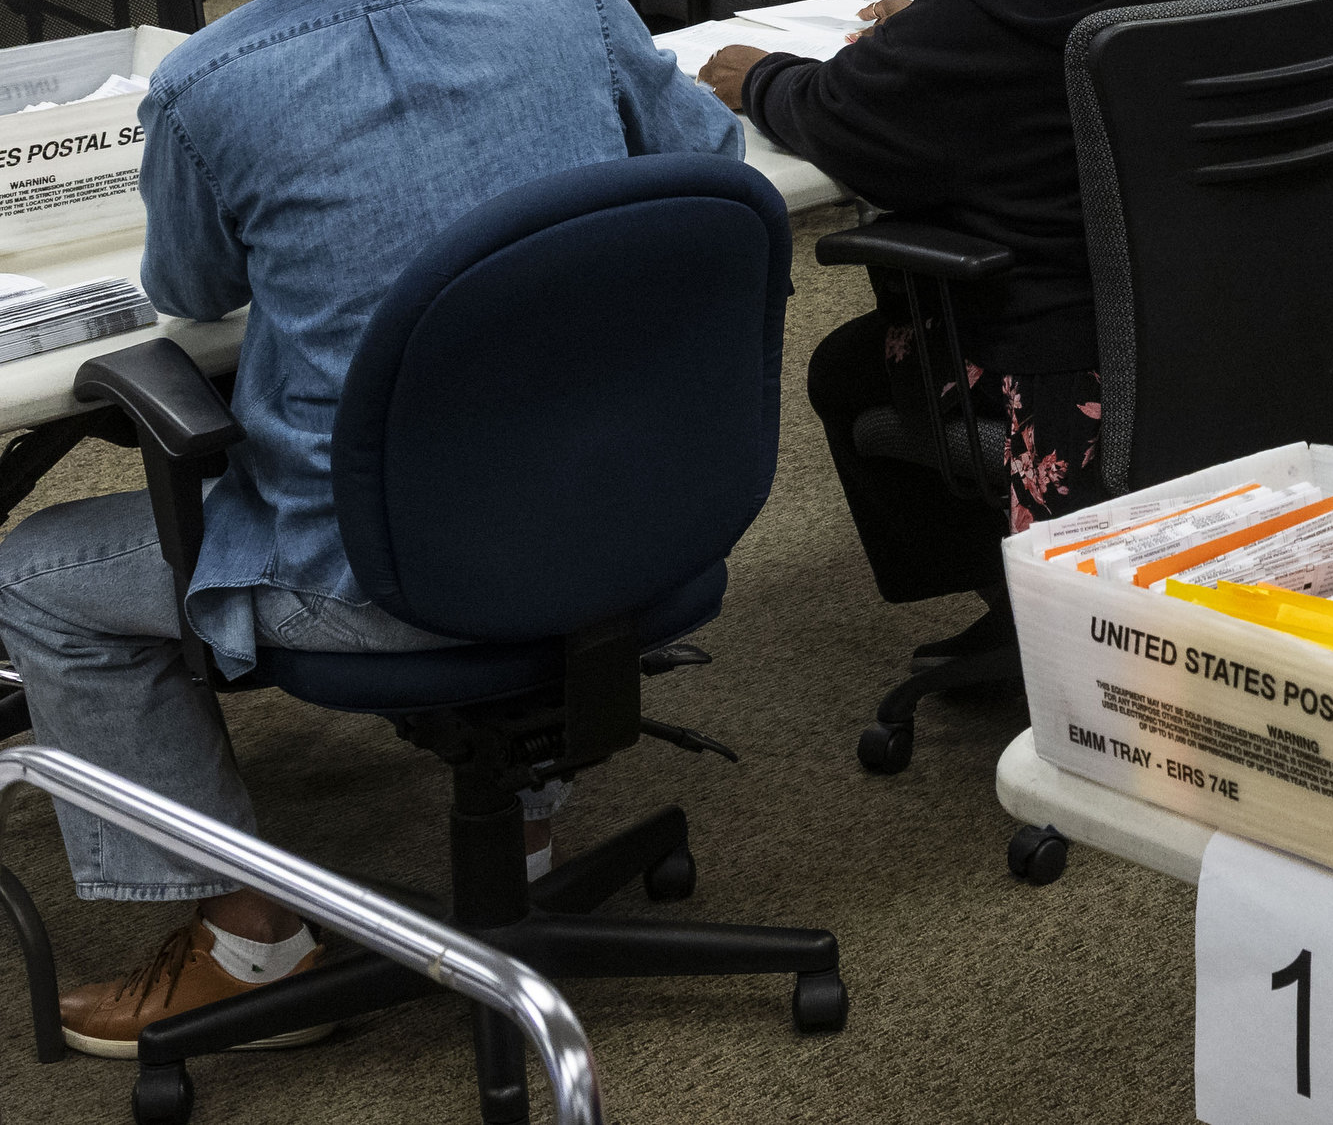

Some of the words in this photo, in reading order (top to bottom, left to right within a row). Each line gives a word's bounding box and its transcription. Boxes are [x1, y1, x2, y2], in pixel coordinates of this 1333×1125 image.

[26, 131, 112, 164] POSTAL
[9, 174, 56, 190] WARNING
[30, 183, 65, 194] PERMISSION
[94, 173, 115, 182] POSTAL
[1091, 616, 1178, 666] UNITED
[1184, 647, 1276, 701] STATES
[1266, 724, 1320, 754] WARNING
[1067, 725, 1106, 754] EMM
[1109, 738, 1152, 769] TRAY
[1166, 758, 1205, 788] EIRS
[1209, 774, 1240, 801] 74E
